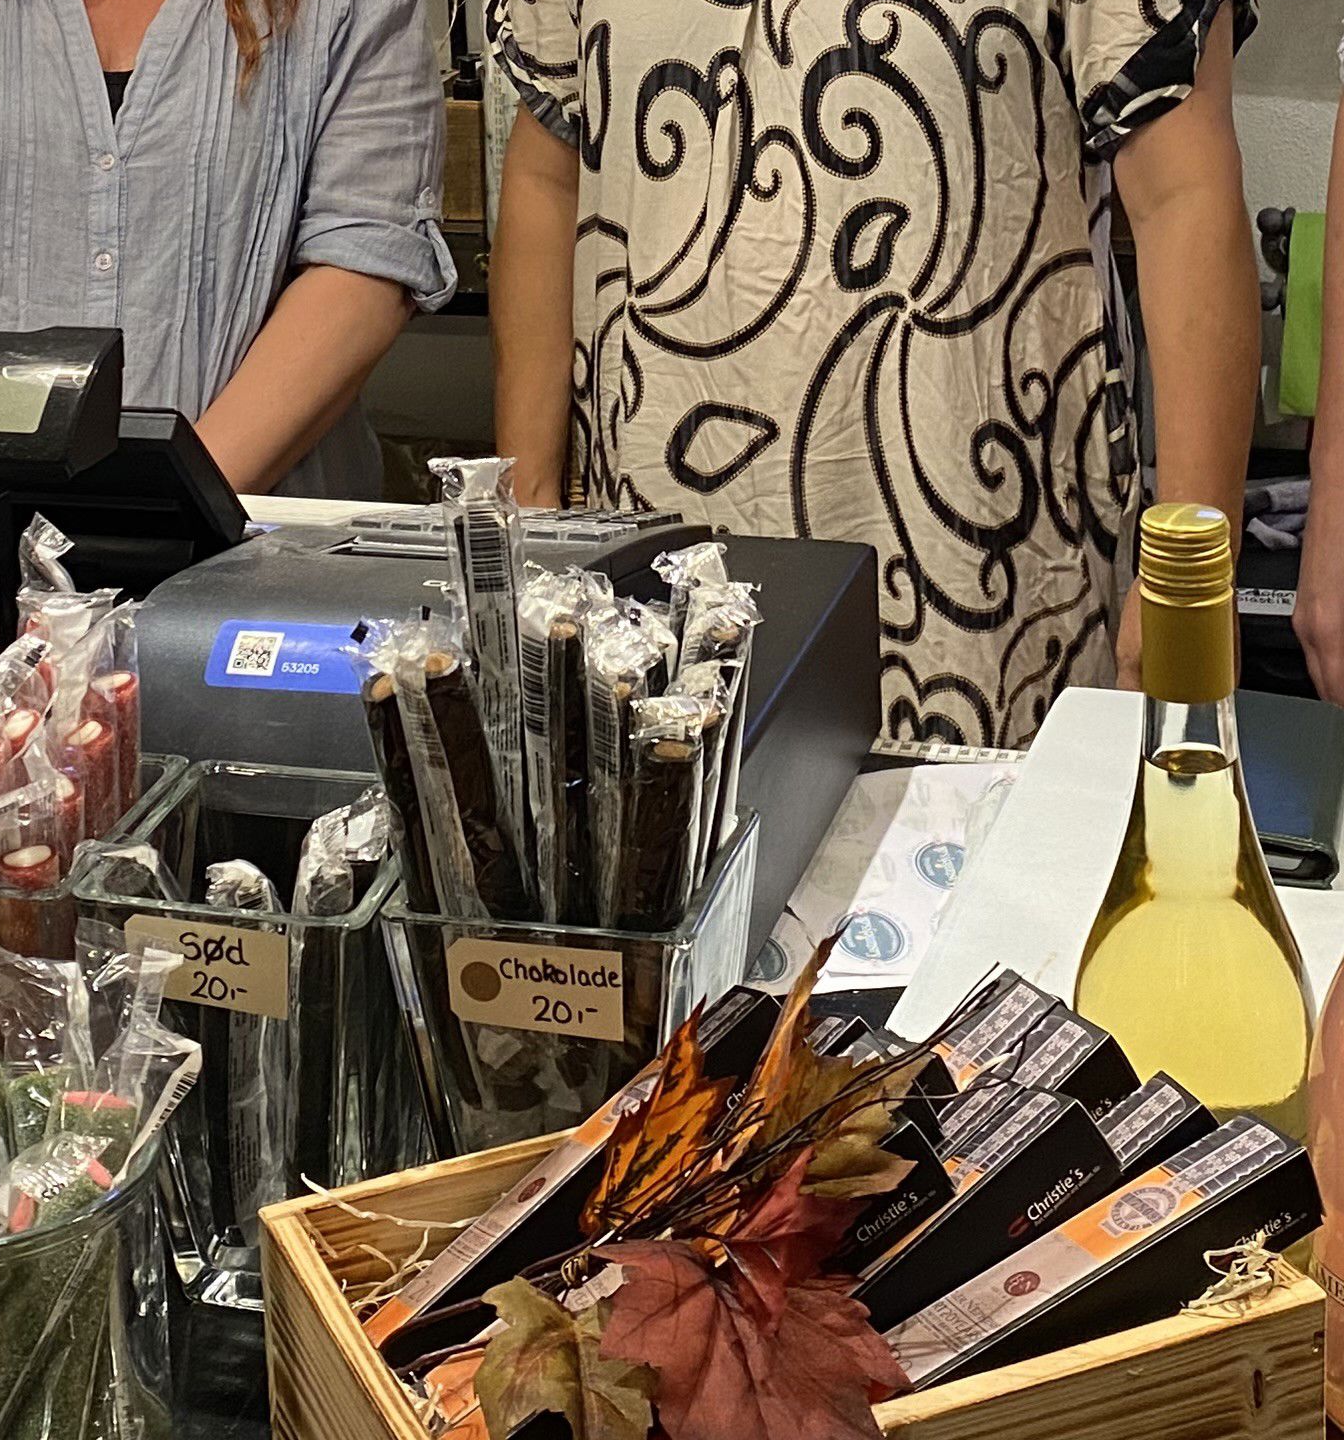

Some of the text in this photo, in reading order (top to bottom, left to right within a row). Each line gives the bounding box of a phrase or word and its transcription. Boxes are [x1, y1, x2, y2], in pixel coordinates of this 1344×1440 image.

[190, 971, 248, 1001] 20,-
[499, 957, 622, 988] Chokolade
[532, 995, 598, 1024] 20,-
[1025, 1166, 1085, 1223] Christie's
[855, 1190, 918, 1244] Christie's
[1233, 1211, 1293, 1248] Chritie's
